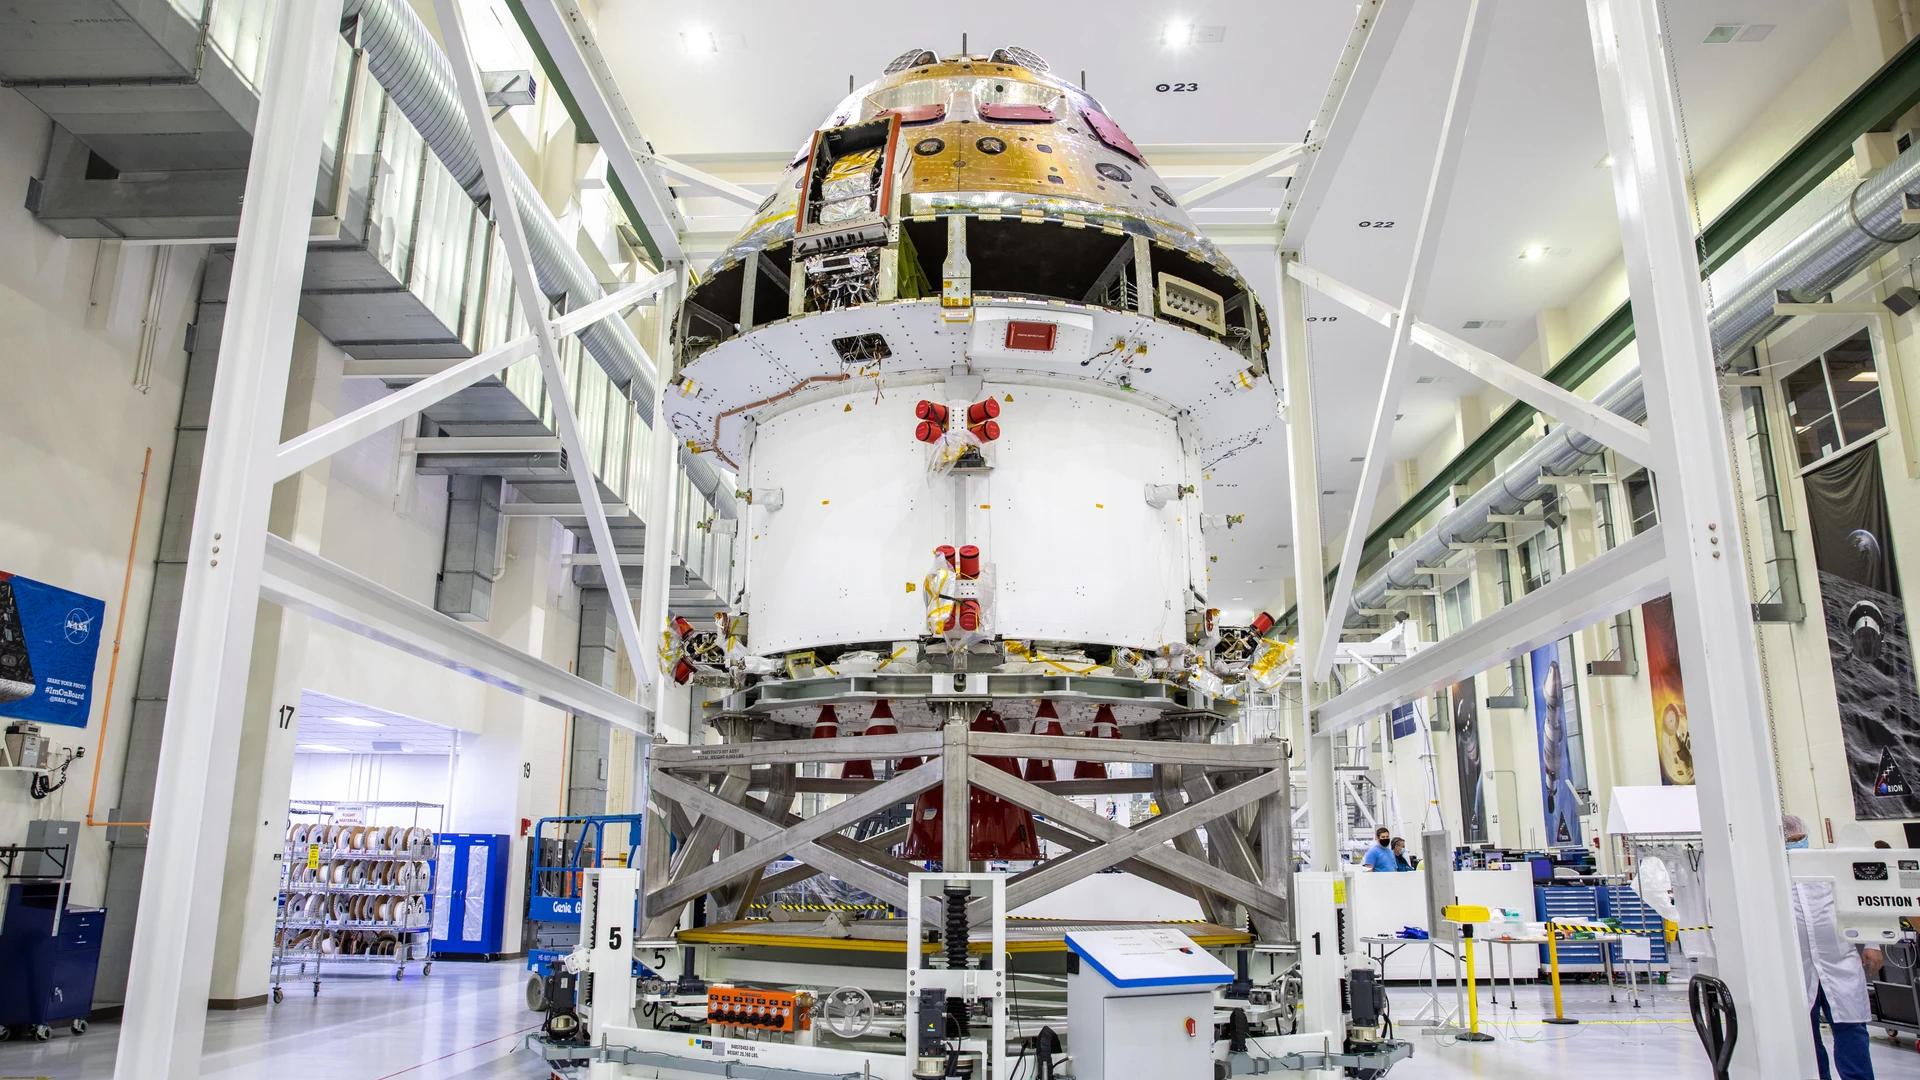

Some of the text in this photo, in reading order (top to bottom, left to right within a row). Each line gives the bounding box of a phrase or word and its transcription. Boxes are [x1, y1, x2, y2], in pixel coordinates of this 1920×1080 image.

[47, 677, 60, 685] SHARE
[73, 682, 87, 690] PHOTO
[45, 686, 85, 700] #ImOnBoard
[279, 704, 295, 730] 17
[523, 761, 531, 779] 19
[553, 900, 572, 914] Genie
[1857, 895, 1913, 907] POSITION
[608, 926, 622, 950] 5
[1311, 931, 1321, 955] 1
[654, 949, 666, 970] 5
